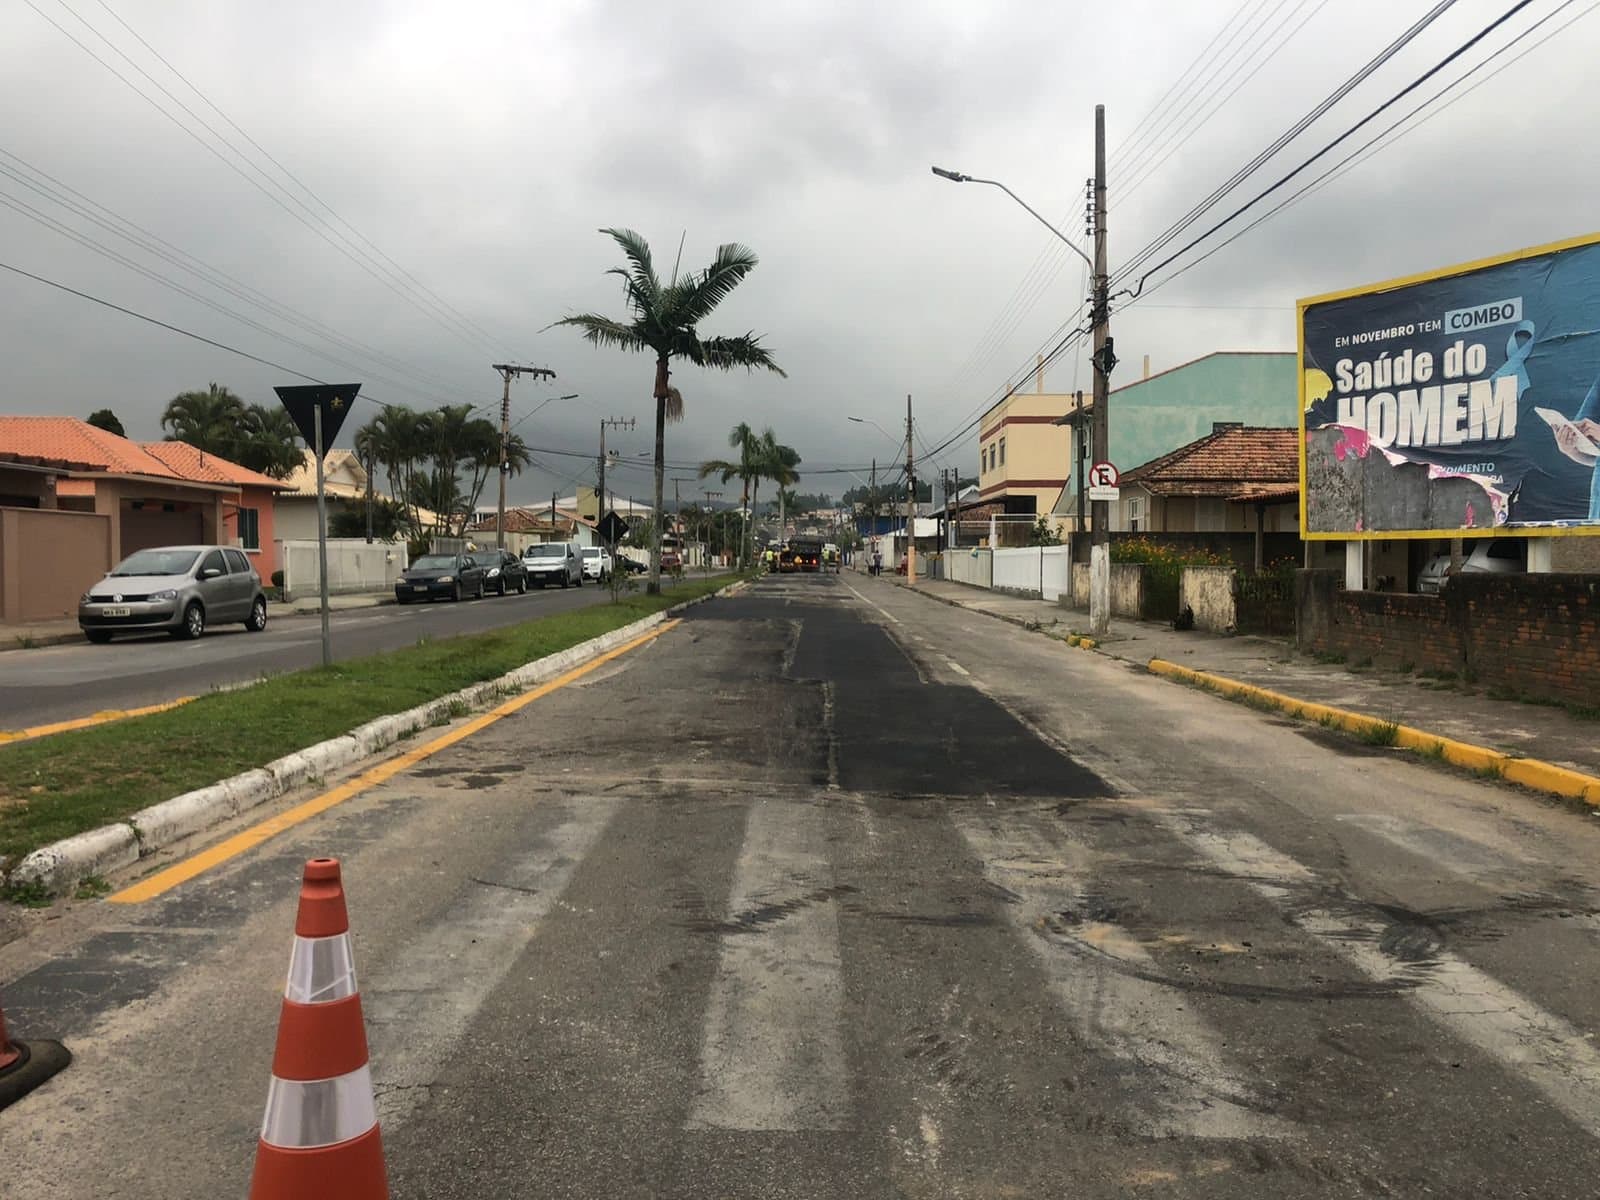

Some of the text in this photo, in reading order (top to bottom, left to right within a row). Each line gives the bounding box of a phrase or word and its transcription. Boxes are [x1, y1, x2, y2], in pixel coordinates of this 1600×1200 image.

[1335, 303, 1515, 348] EM NOVEMBRO TEM COMBO
[1335, 340, 1488, 393] Saúde do
[1336, 374, 1519, 449] HOMEM
